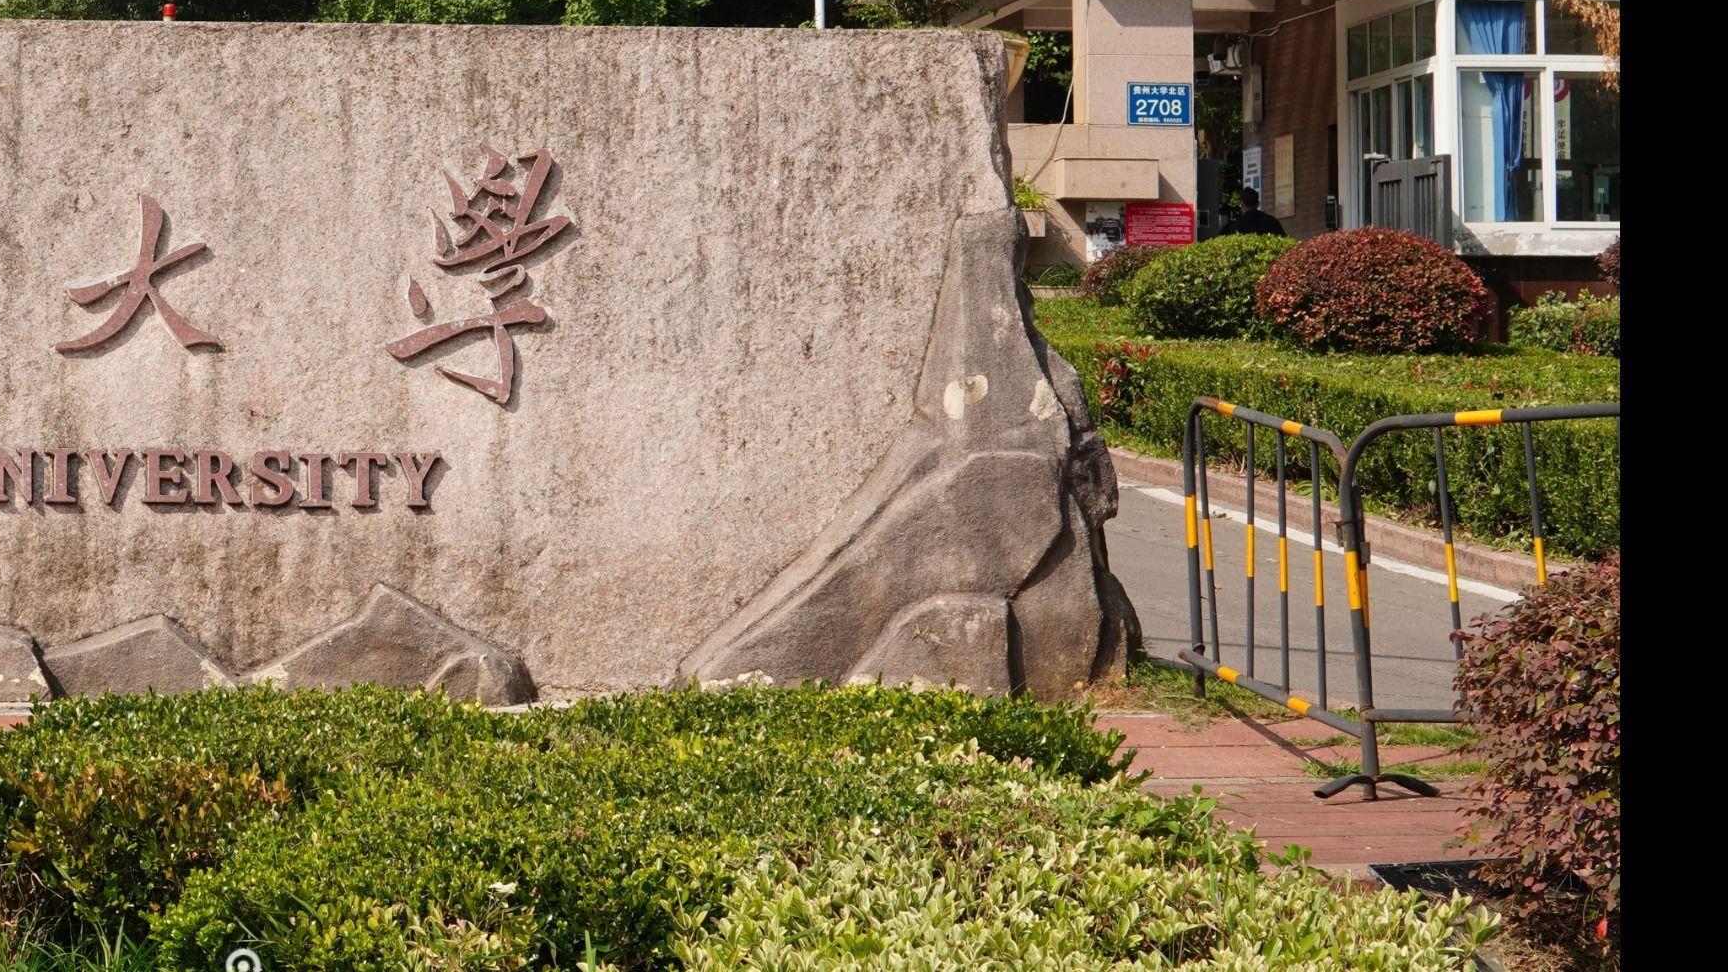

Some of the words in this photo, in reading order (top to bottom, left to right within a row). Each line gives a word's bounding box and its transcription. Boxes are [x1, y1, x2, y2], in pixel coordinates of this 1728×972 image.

[1133, 86, 1186, 95] 贵州大学北区
[1136, 99, 1182, 116] 2708
